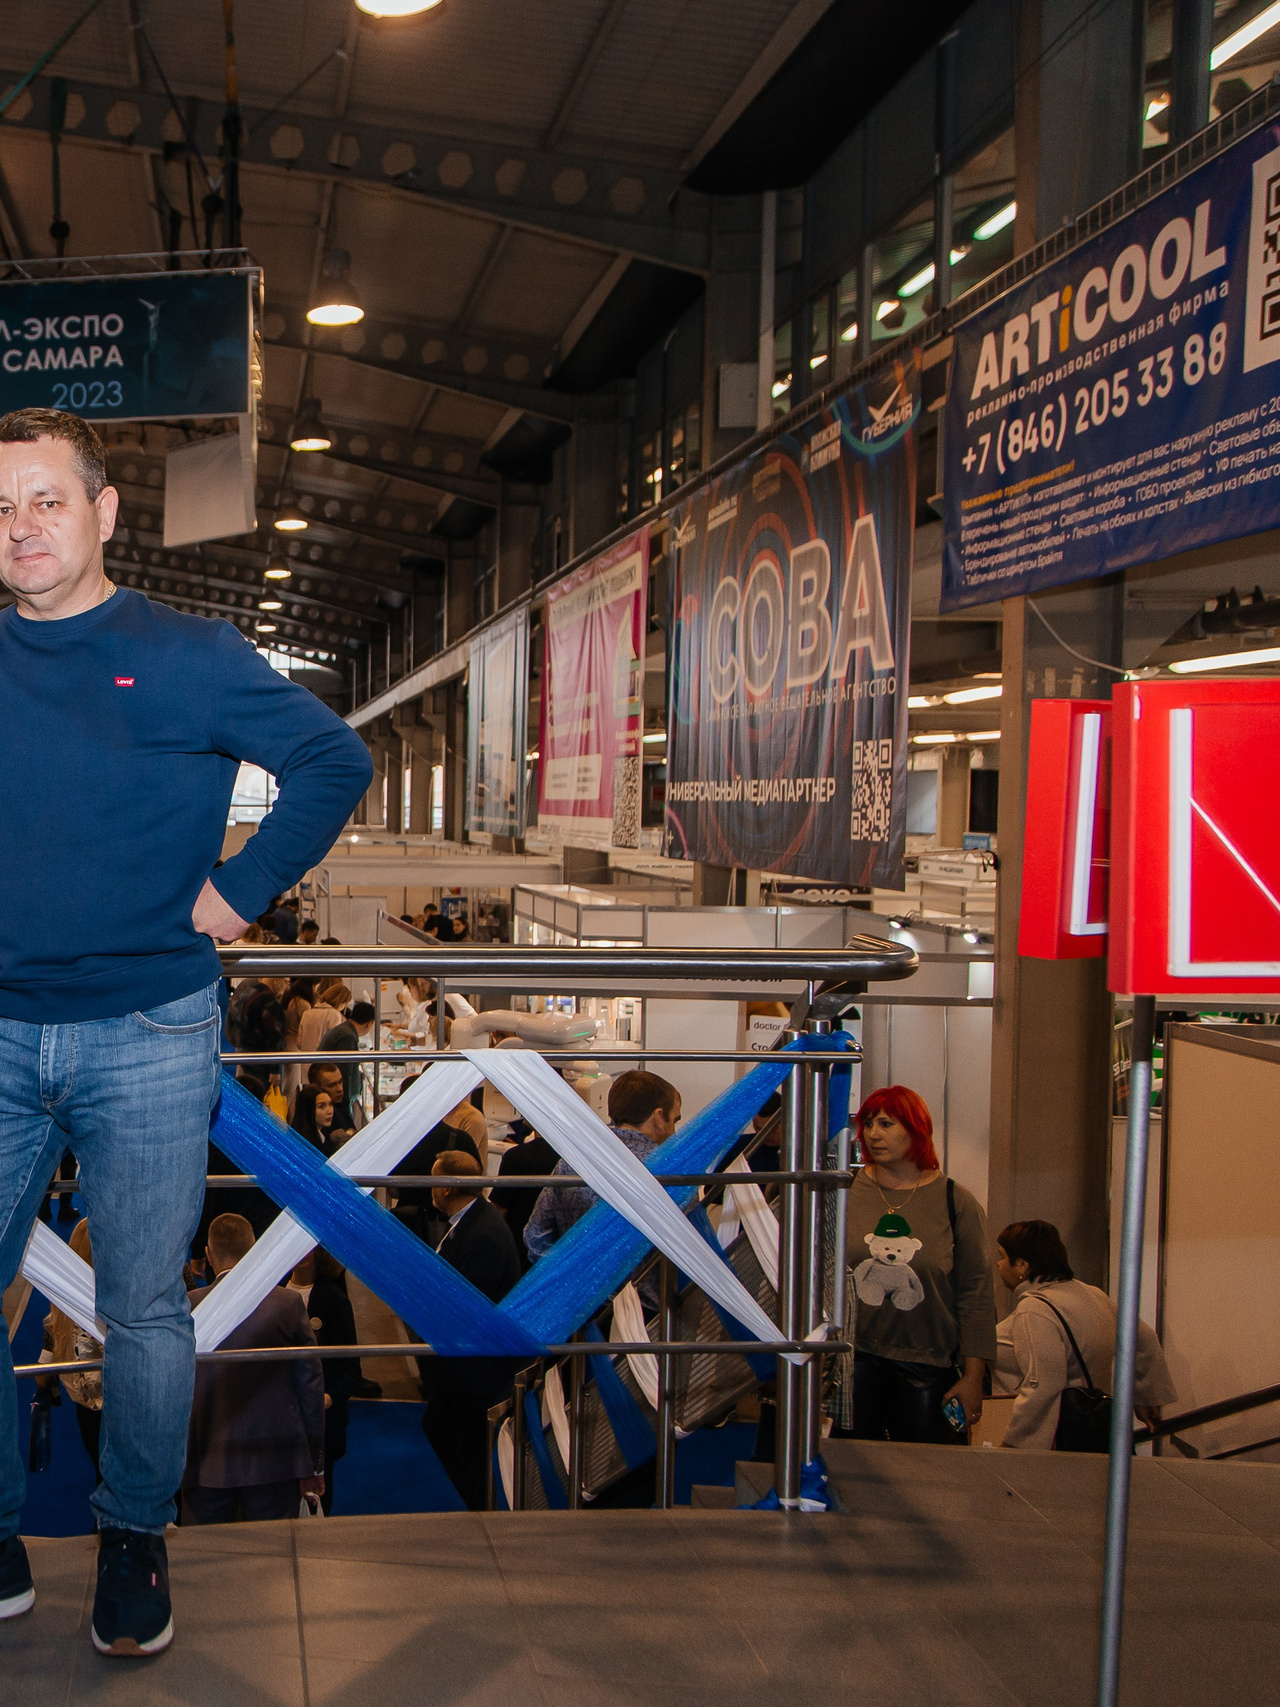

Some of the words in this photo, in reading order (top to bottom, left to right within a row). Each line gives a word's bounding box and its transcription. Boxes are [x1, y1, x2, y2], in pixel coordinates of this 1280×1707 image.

[970, 199, 1227, 400] ARTiCOOL
[2, 344, 124, 373] САМАРА
[967, 313, 1164, 428] рекламно-производственная
[1169, 280, 1230, 327] фирма
[51, 380, 124, 410] 2023
[961, 433, 991, 475] +7
[996, 392, 1068, 474] (846)
[1075, 368, 1130, 435] 205
[1137, 346, 1174, 406] 33
[1183, 321, 1227, 385] 88
[1153, 443, 1170, 459] вас
[1215, 407, 1259, 437] рекламу
[1209, 427, 1260, 456] Световые
[1230, 447, 1268, 469] печать
[1224, 477, 1237, 492] из
[1237, 464, 1280, 487] гибкого
[707, 512, 895, 704] СОВА
[841, 676, 897, 702] АГЕНТСТВО
[743, 776, 837, 806] МЕДИАПАРТНЕР
[753, 1021, 781, 1031] doctor
